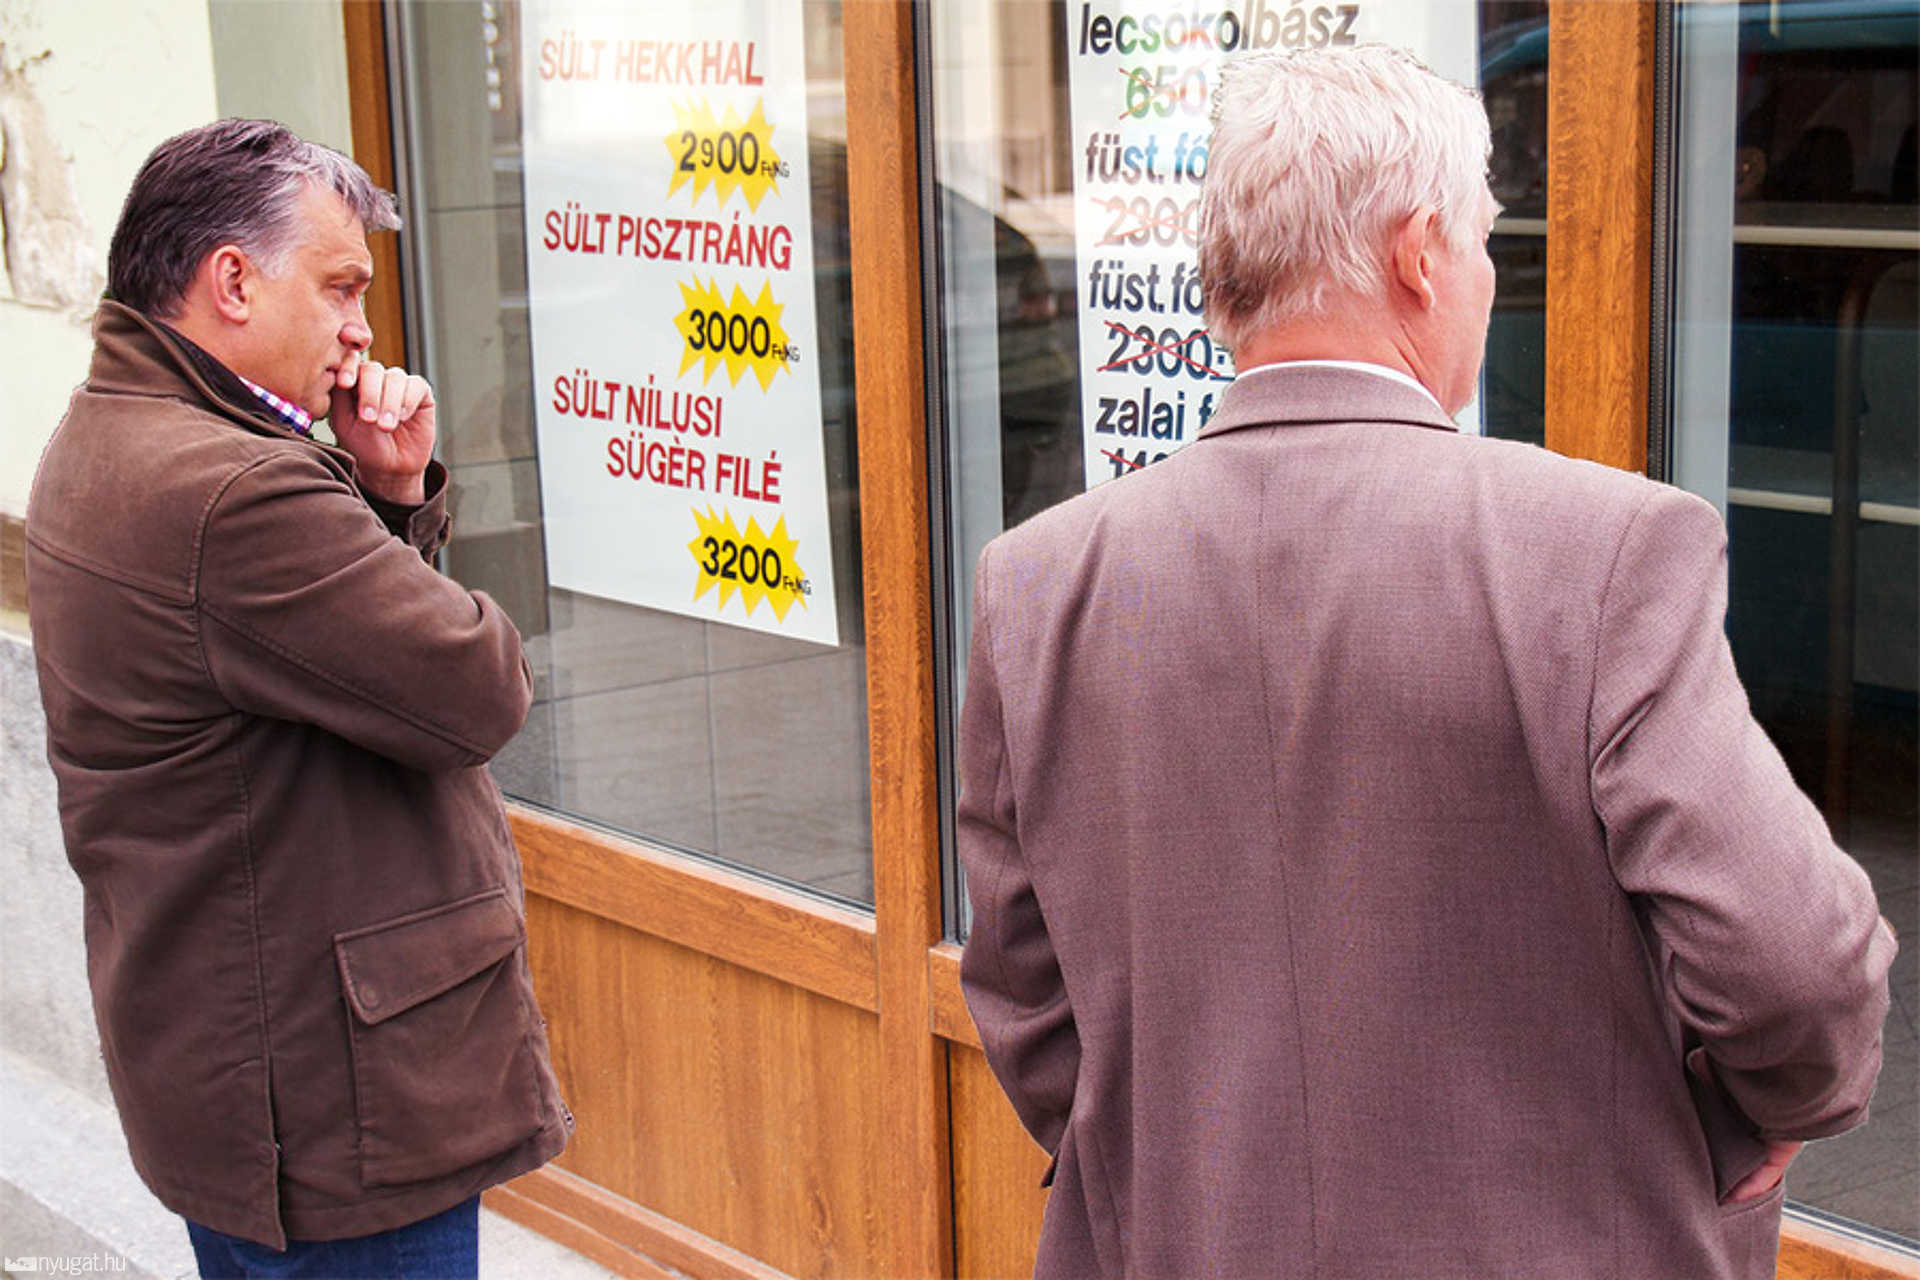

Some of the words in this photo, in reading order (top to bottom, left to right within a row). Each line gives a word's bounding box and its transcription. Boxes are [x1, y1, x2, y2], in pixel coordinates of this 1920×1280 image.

[680, 131, 759, 175] 2900
[543, 201, 612, 254] SÜLT
[617, 210, 793, 271] PISZTRÁNG
[688, 308, 770, 358] 3000
[553, 368, 621, 420] SÜLT
[626, 373, 723, 438] NÍLUSI
[1095, 387, 1185, 441] zalai
[715, 450, 782, 503] FILÉ
[702, 536, 782, 588] 3200
